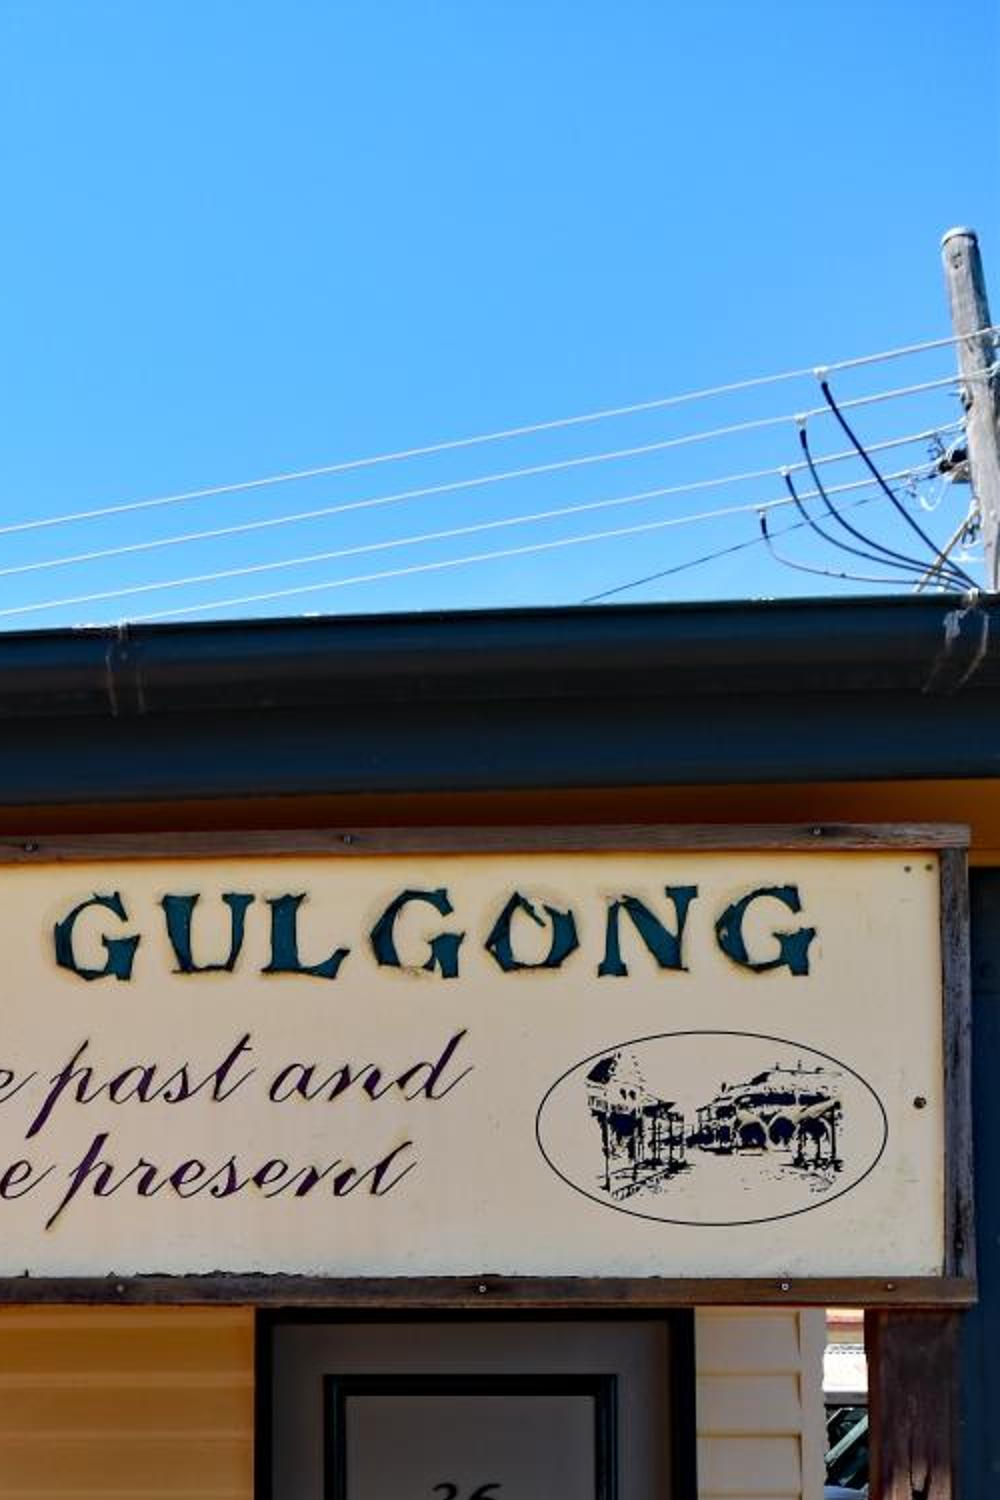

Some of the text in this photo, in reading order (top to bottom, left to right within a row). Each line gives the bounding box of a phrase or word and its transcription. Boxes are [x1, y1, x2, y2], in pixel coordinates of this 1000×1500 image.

[53, 885, 818, 981] GULGONG
[25, 1033, 256, 1139] past
[269, 1029, 474, 1103] and
[45, 1133, 417, 1231] present
